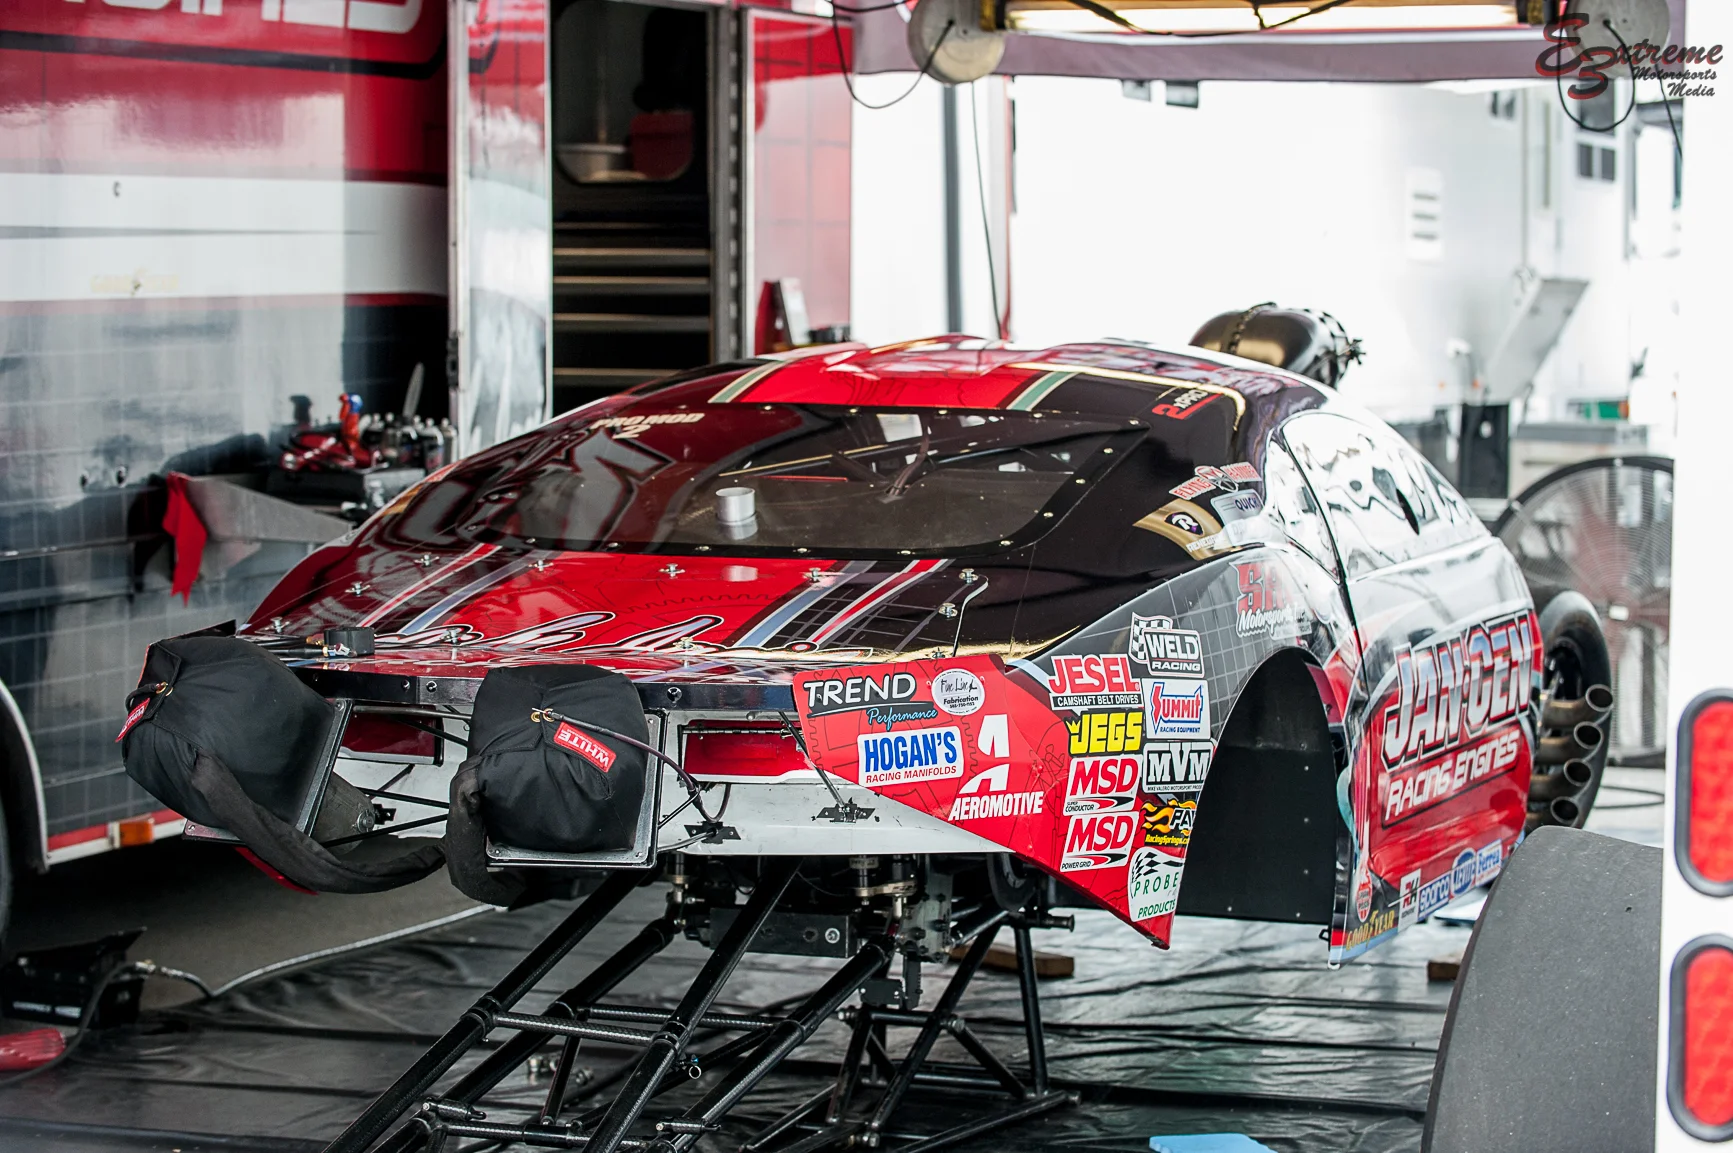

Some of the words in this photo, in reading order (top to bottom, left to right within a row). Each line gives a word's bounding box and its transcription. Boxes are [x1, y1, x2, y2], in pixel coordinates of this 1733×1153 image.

[590, 416, 645, 430] PRO
[641, 413, 706, 424] MOD
[612, 424, 651, 440] 2
[1145, 633, 1200, 660] WELD
[1049, 657, 1140, 694] JESEL
[1151, 661, 1201, 671] RACING
[803, 673, 917, 706] TREND
[943, 695, 979, 705] Fabrication
[1057, 695, 1096, 707] CAMSHAFT
[1097, 695, 1114, 705] BELT
[1115, 694, 1139, 704] DRIVES
[867, 706, 938, 731] Performance
[1070, 712, 1143, 755] JEGS
[557, 729, 610, 768] WHITE
[864, 731, 958, 773] HOGAN'S
[866, 771, 902, 784] RACING
[903, 766, 957, 779] MANIFOLDS
[1147, 743, 1210, 782] MVM
[1385, 757, 1452, 820] RACING
[1452, 730, 1520, 790] ENGINES
[1070, 758, 1139, 796] MSD
[948, 791, 1045, 821] AEROMOTIVE
[1065, 804, 1095, 813] CONDUCTOR
[1067, 815, 1134, 853] MSD
[1134, 871, 1180, 897] PROBE
[1138, 899, 1176, 919] PRODUCTS
